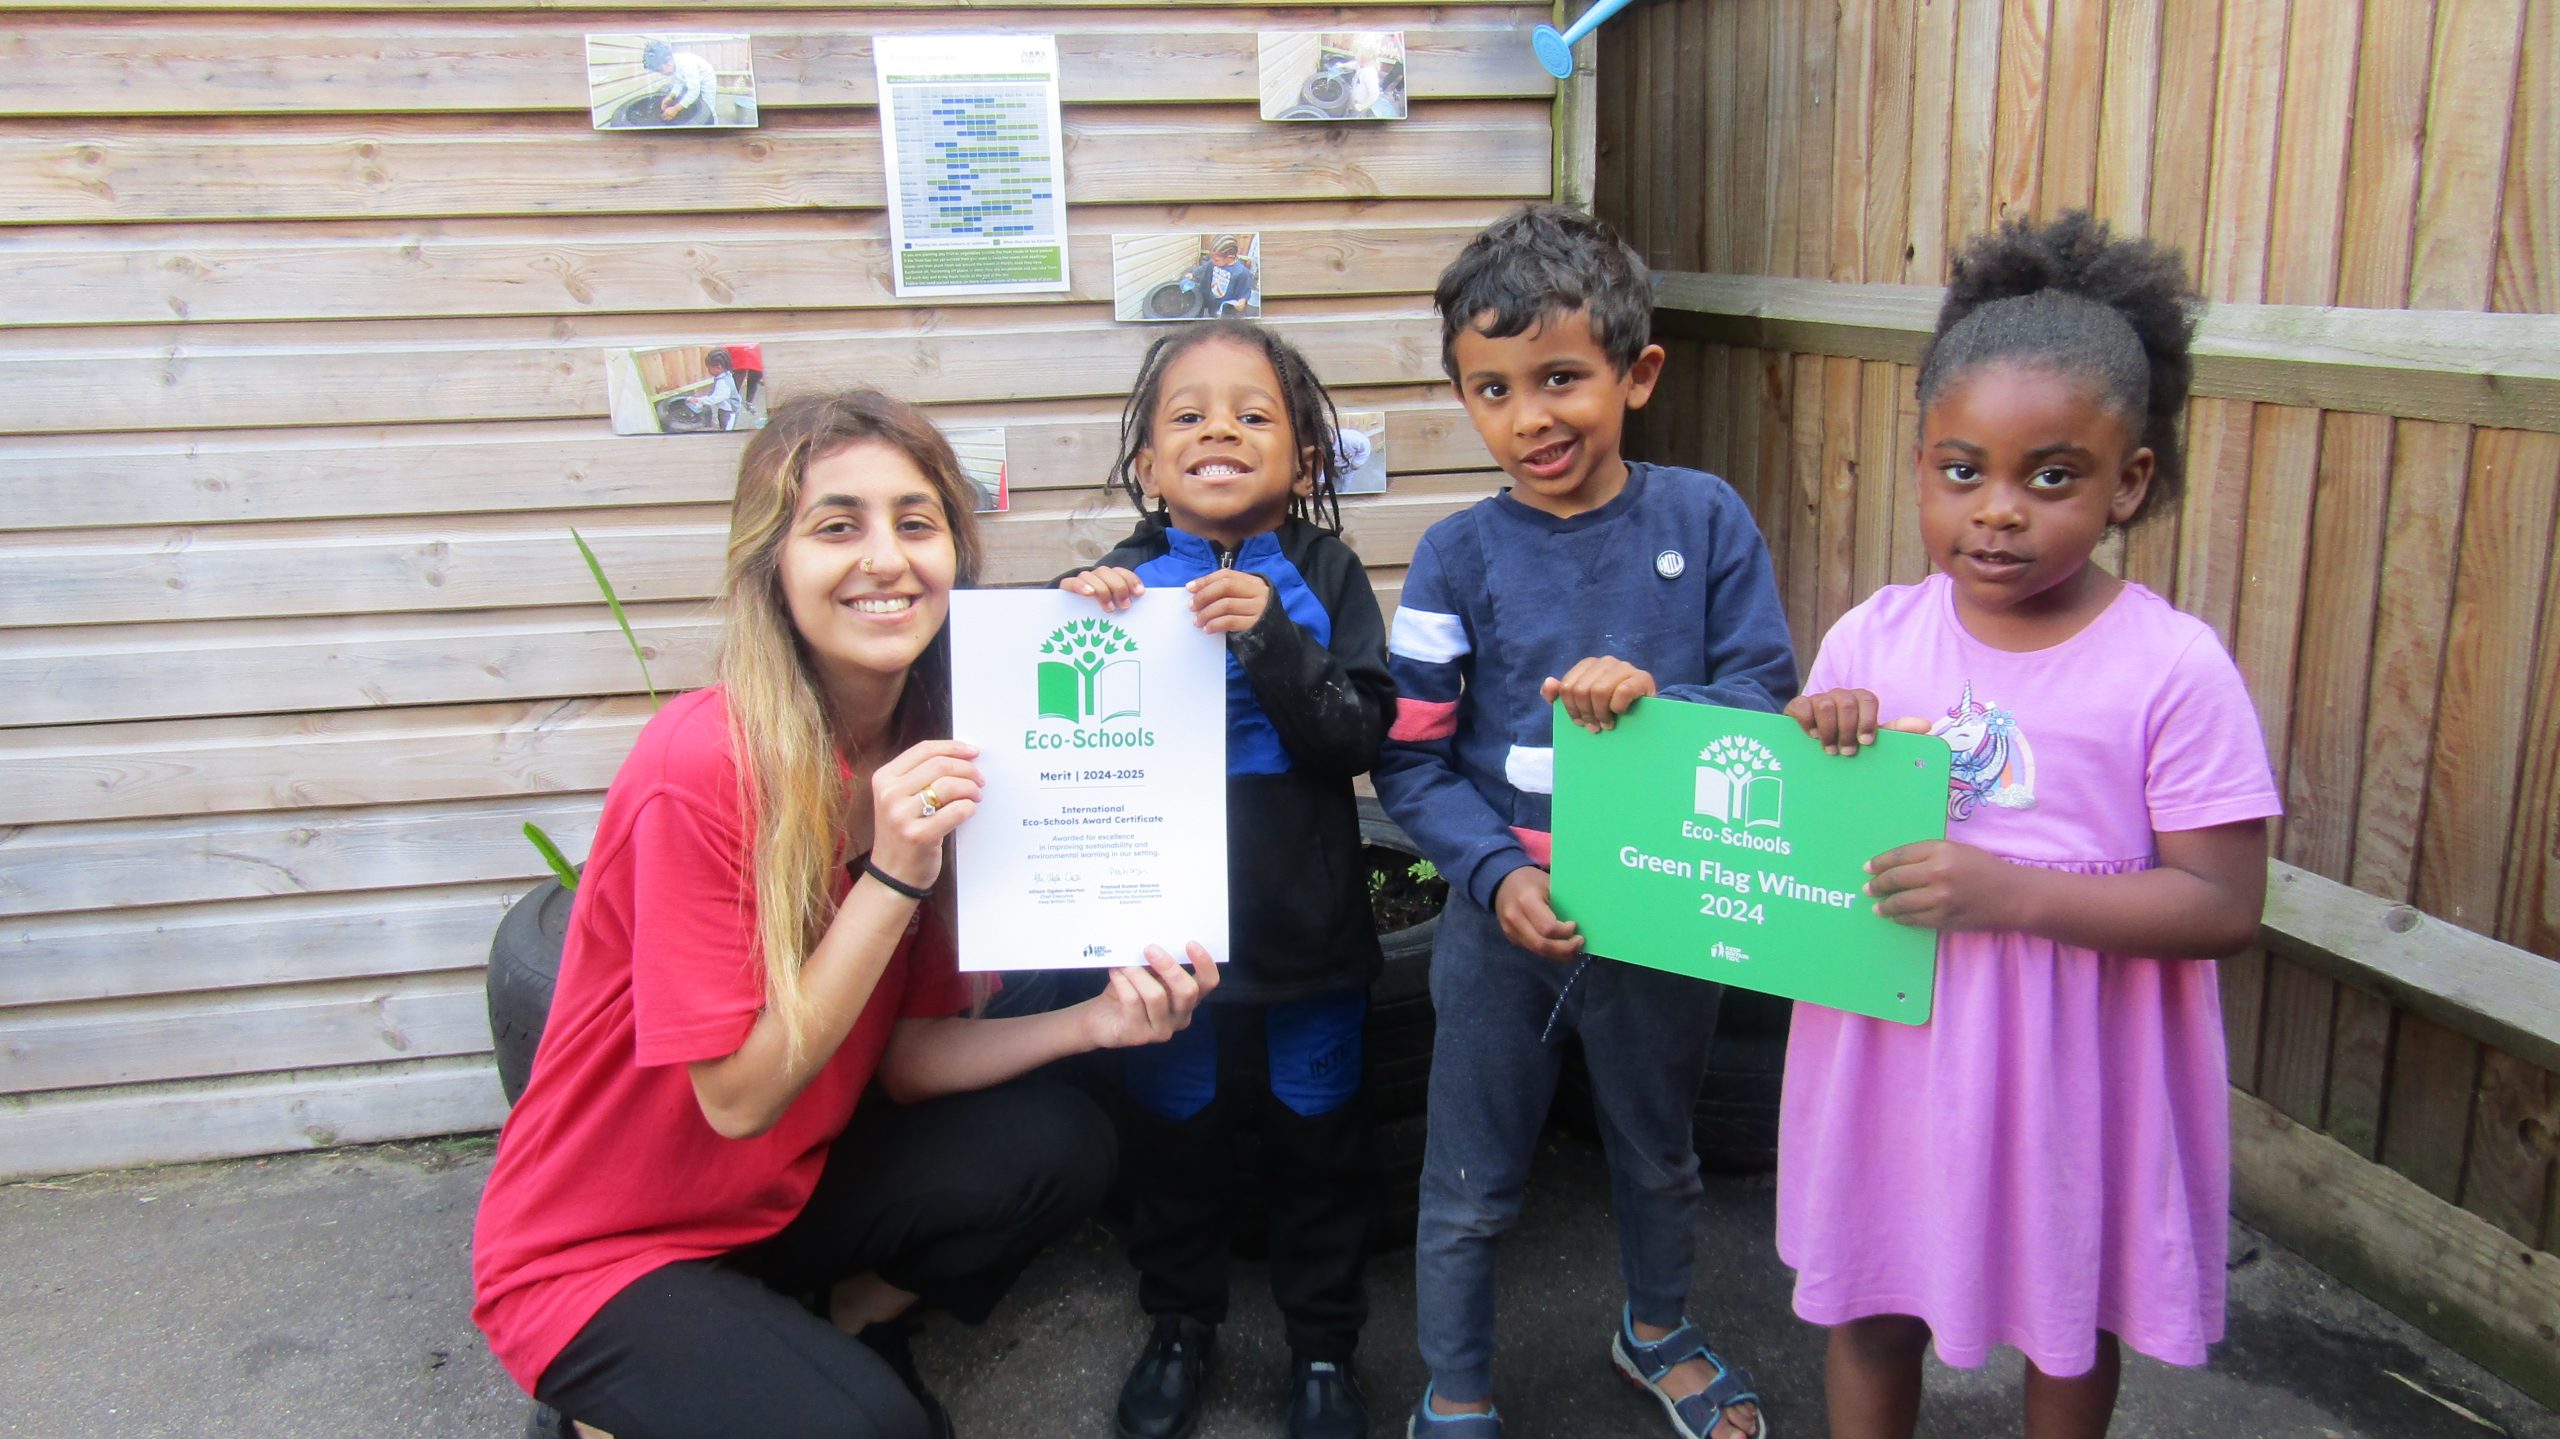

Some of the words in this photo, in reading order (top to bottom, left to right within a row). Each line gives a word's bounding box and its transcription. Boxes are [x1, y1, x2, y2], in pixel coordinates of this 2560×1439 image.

[1025, 727, 1154, 750] Eco-Schools
[1040, 770, 1072, 781] Merit
[1083, 769, 1145, 780] 2024-2025
[1061, 804, 1125, 814] International
[1022, 817, 1079, 827] Eco-Schools
[1082, 816, 1112, 825] Award
[1114, 814, 1163, 824] Certificate
[1052, 834, 1084, 842] Awarded
[1681, 820, 1791, 855] Eco-Schools
[1047, 842, 1084, 852] improving
[1085, 841, 1133, 850] sustainability
[1027, 852, 1079, 860] environmental
[1080, 851, 1110, 859] learning
[1619, 846, 1692, 878] Green
[1699, 859, 1751, 894] Flag
[1757, 869, 1856, 909] Winner
[1699, 893, 1765, 925] 2024
